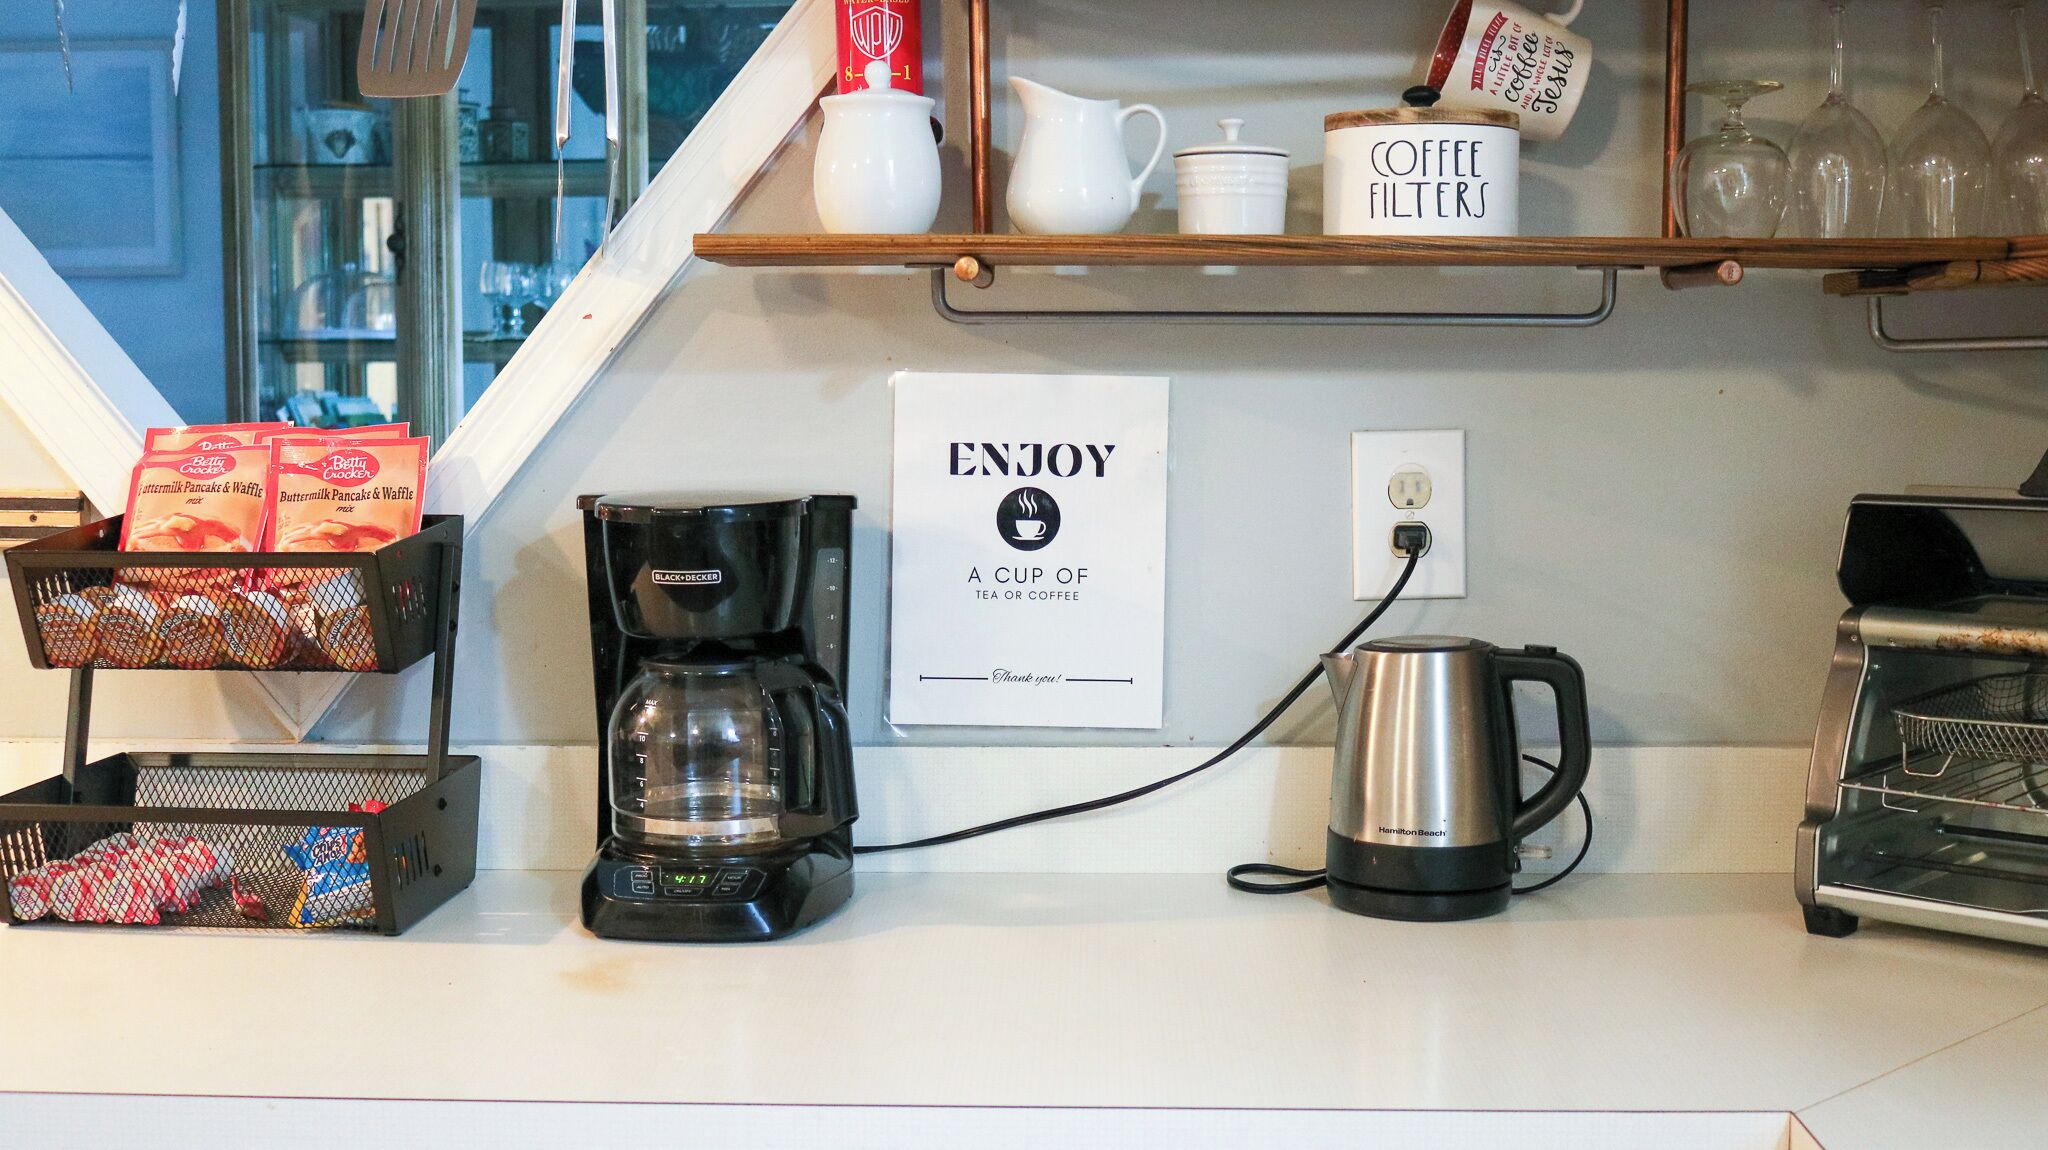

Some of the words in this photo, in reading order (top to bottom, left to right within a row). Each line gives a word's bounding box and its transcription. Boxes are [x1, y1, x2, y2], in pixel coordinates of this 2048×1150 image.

[1512, 21, 1522, 33] OF
[1507, 34, 1520, 52] BIT
[1494, 54, 1513, 87] LITTLE
[1531, 41, 1574, 114] Jesus
[1489, 88, 1498, 96] A
[1520, 94, 1533, 110] AND
[1529, 86, 1537, 94] A
[1533, 59, 1548, 85] WHOLE
[1371, 139, 1483, 178] COFFEE
[1370, 181, 1489, 219] FILTERS
[191, 456, 227, 469] Betty
[328, 455, 368, 471] Betty
[949, 442, 1116, 478] ENJOY
[323, 466, 375, 480] Crocker
[183, 481, 222, 493] Pancake
[222, 482, 230, 493] &
[232, 481, 264, 498] Waffle
[279, 488, 331, 503] Buttermilk
[331, 488, 372, 502] Pancake
[372, 487, 381, 499] &
[382, 486, 414, 500] Waffle
[185, 497, 204, 505] mix
[335, 504, 355, 513] mix
[654, 573, 718, 581] BLACK+DECKER
[967, 566, 982, 583] A
[994, 566, 1044, 584] CUP
[1056, 567, 1089, 584] OF
[976, 590, 998, 600] TEA
[1004, 590, 1022, 600] OR
[1028, 590, 1080, 601] COFFEE
[992, 668, 1033, 684] Thank
[1034, 674, 1062, 687] you!
[1378, 826, 1417, 836] Hamilton
[1418, 829, 1446, 837] Beach
[674, 875, 707, 884] 4:17
